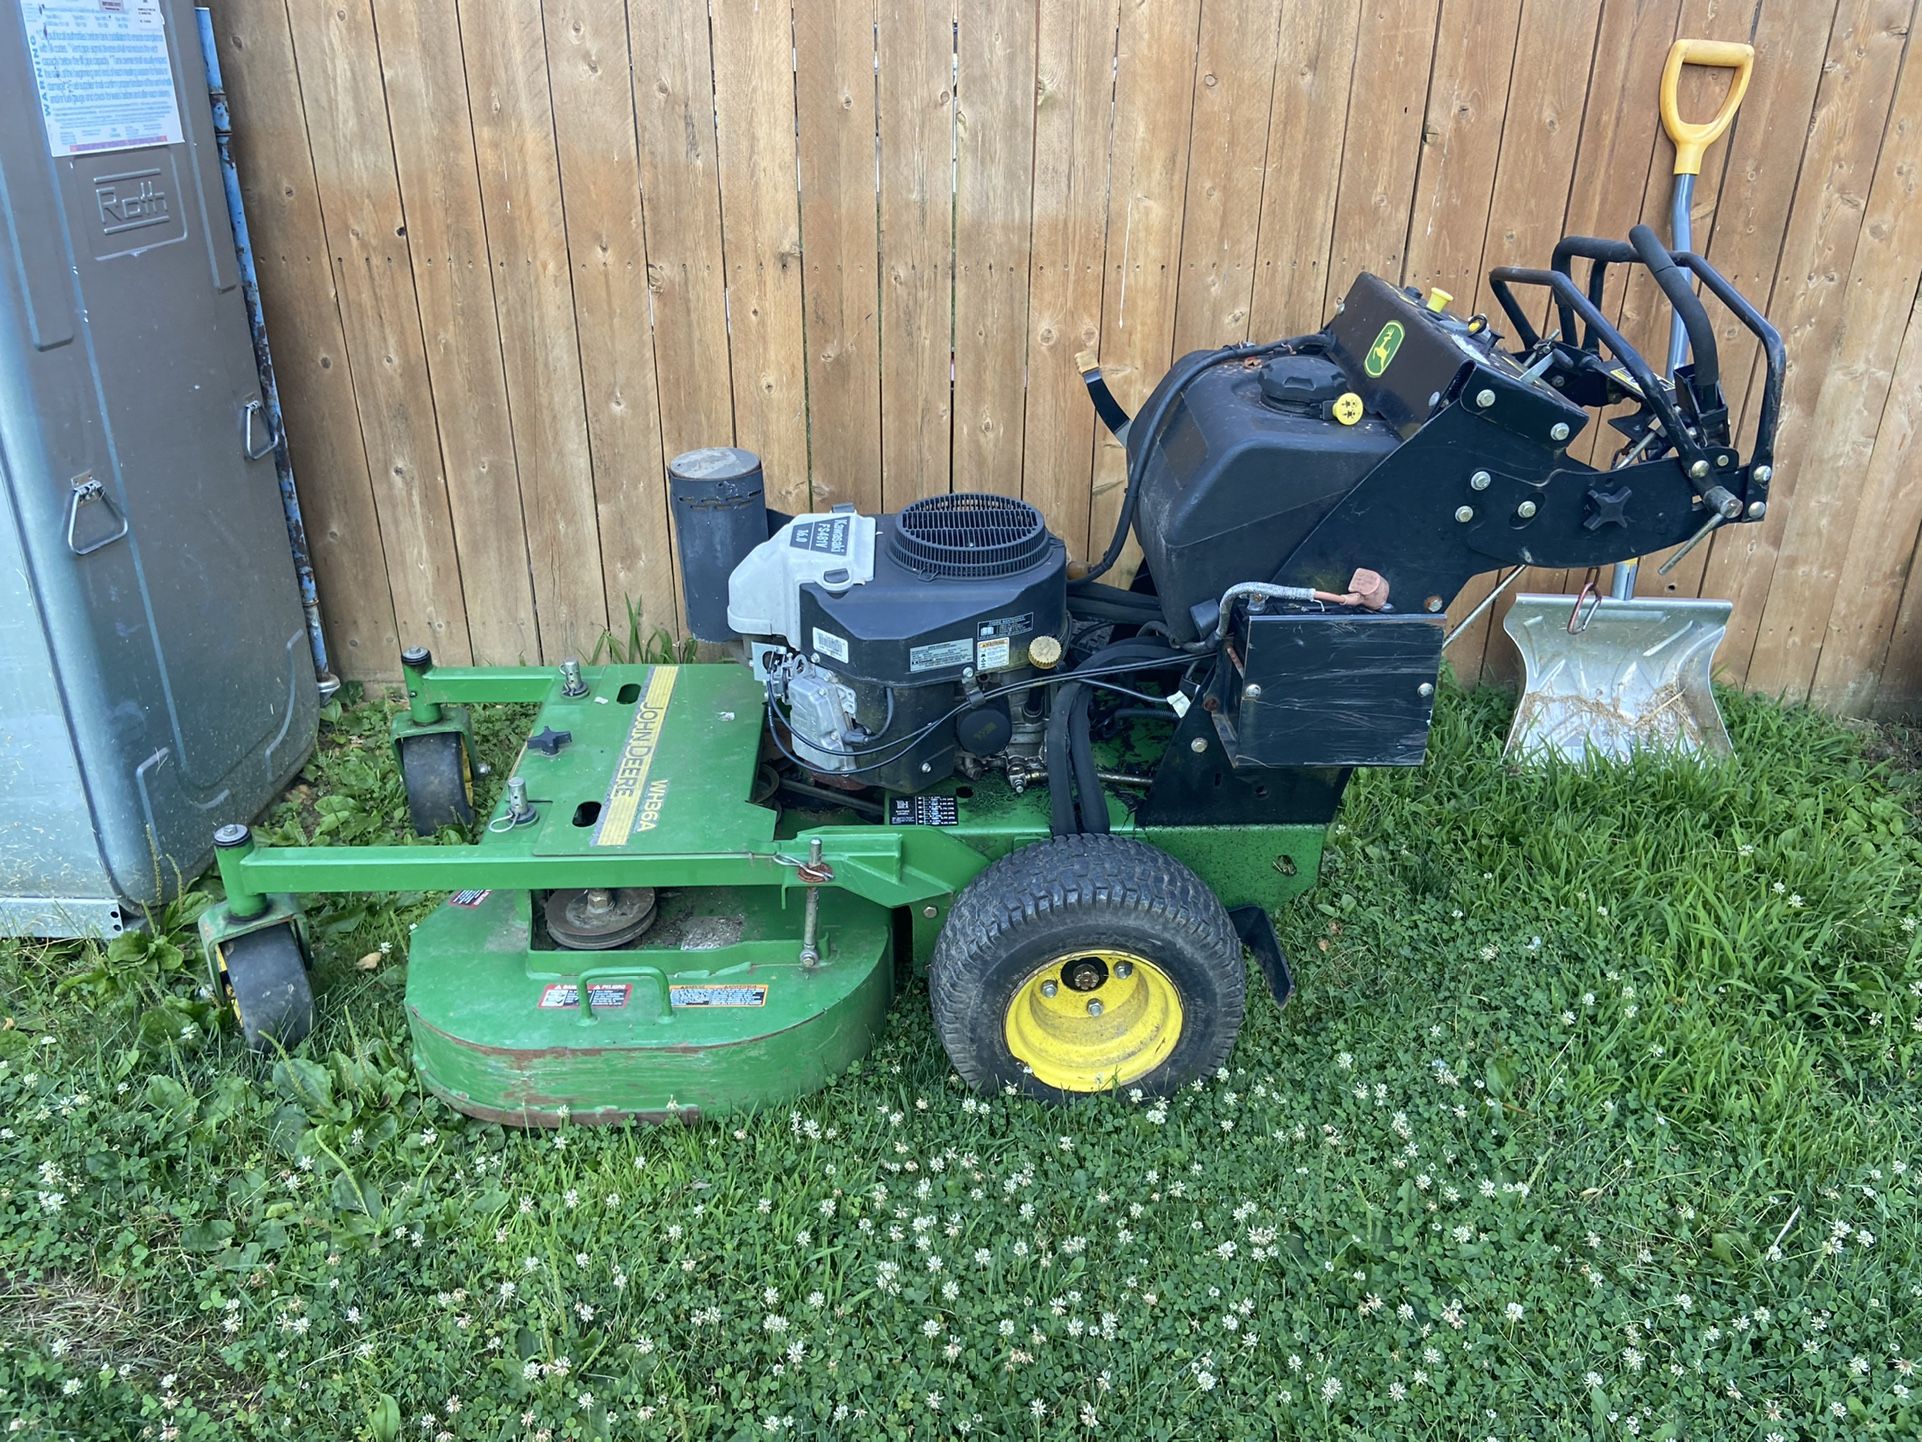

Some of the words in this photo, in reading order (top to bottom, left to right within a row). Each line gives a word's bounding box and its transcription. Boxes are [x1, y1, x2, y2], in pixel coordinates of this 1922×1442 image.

[96, 181, 168, 224] Roth
[830, 519, 848, 553] Kawasaki
[632, 702, 664, 746] JOHN
[614, 746, 652, 797] DEERE
[637, 779, 668, 833] WH36A
